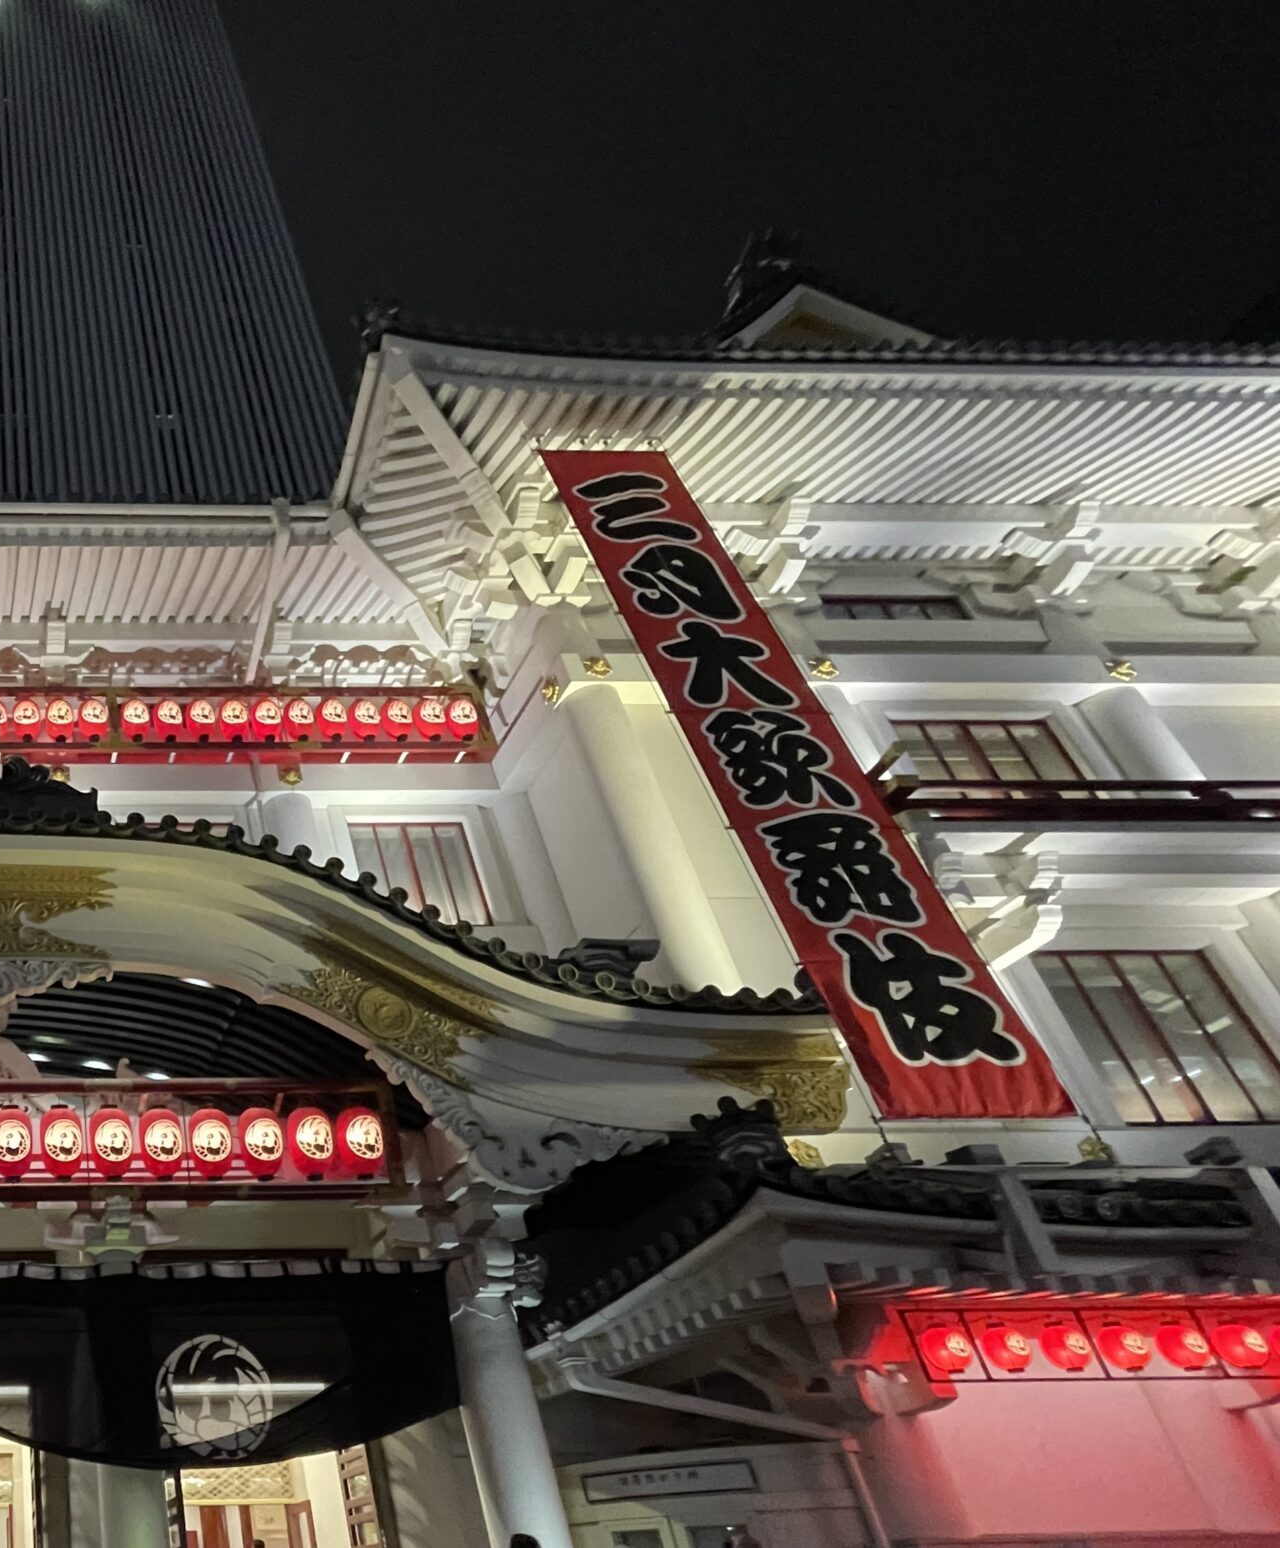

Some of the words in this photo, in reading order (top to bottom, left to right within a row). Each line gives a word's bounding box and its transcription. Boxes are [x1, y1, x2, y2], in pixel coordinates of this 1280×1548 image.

[572, 472, 1028, 1067] 三月大歌舞伎
